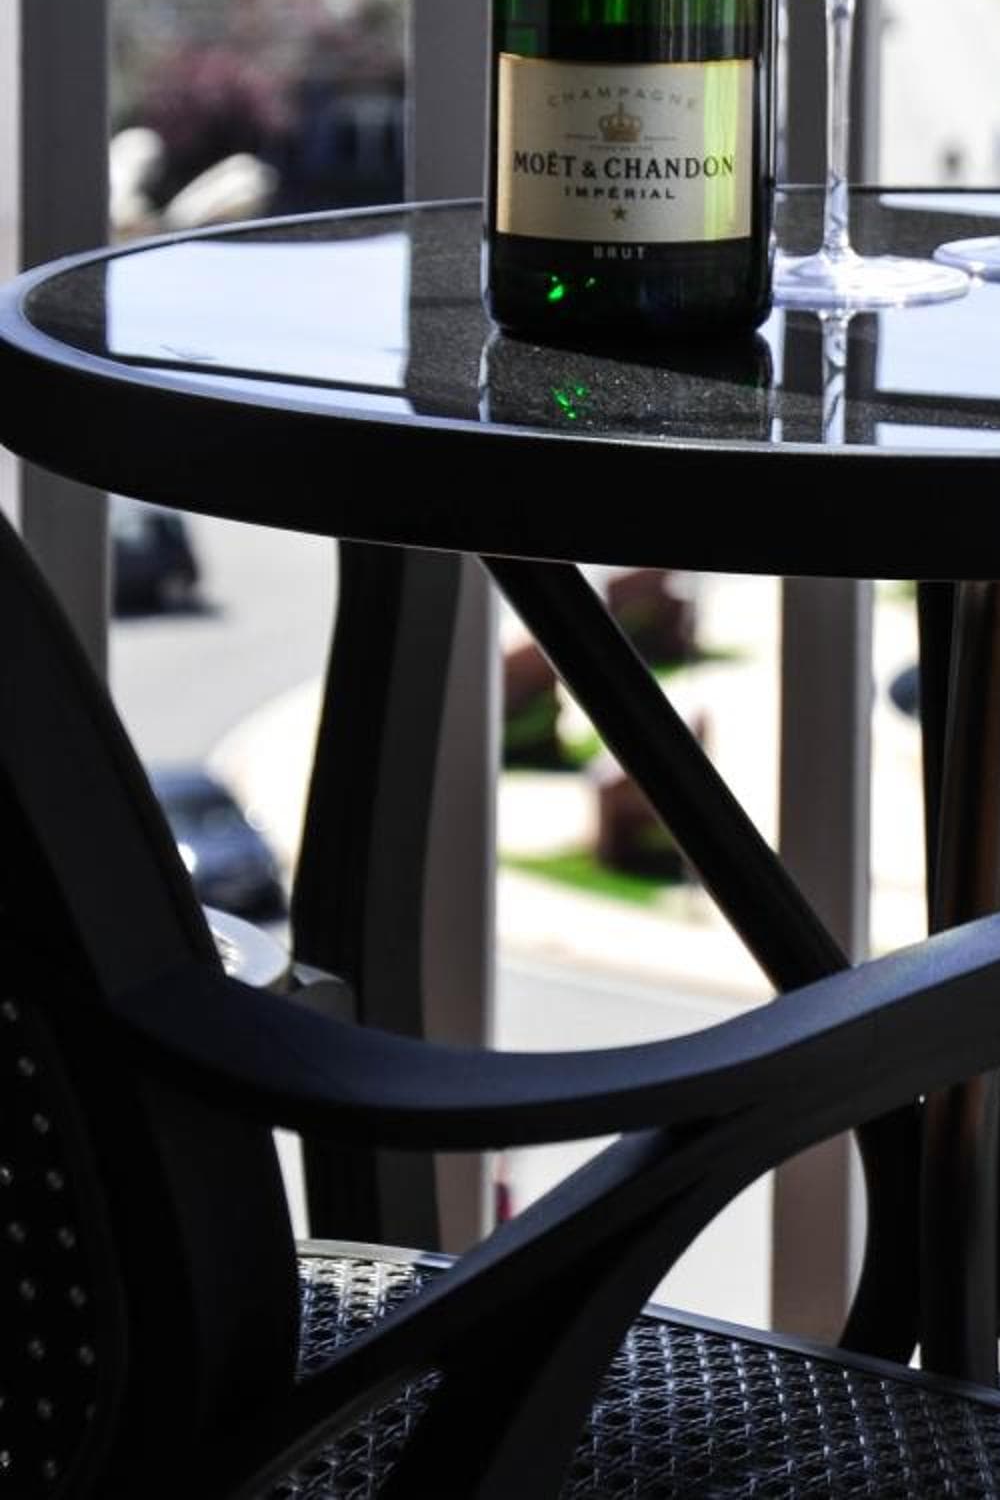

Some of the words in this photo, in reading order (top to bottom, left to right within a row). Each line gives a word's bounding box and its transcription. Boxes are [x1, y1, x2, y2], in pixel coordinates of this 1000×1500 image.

[547, 85, 699, 109] CHAMPAGNE
[580, 161, 597, 179] &
[602, 154, 735, 181] CHANDON
[565, 185, 675, 200] IMPÉRIAL
[593, 245, 646, 260] BRUT
